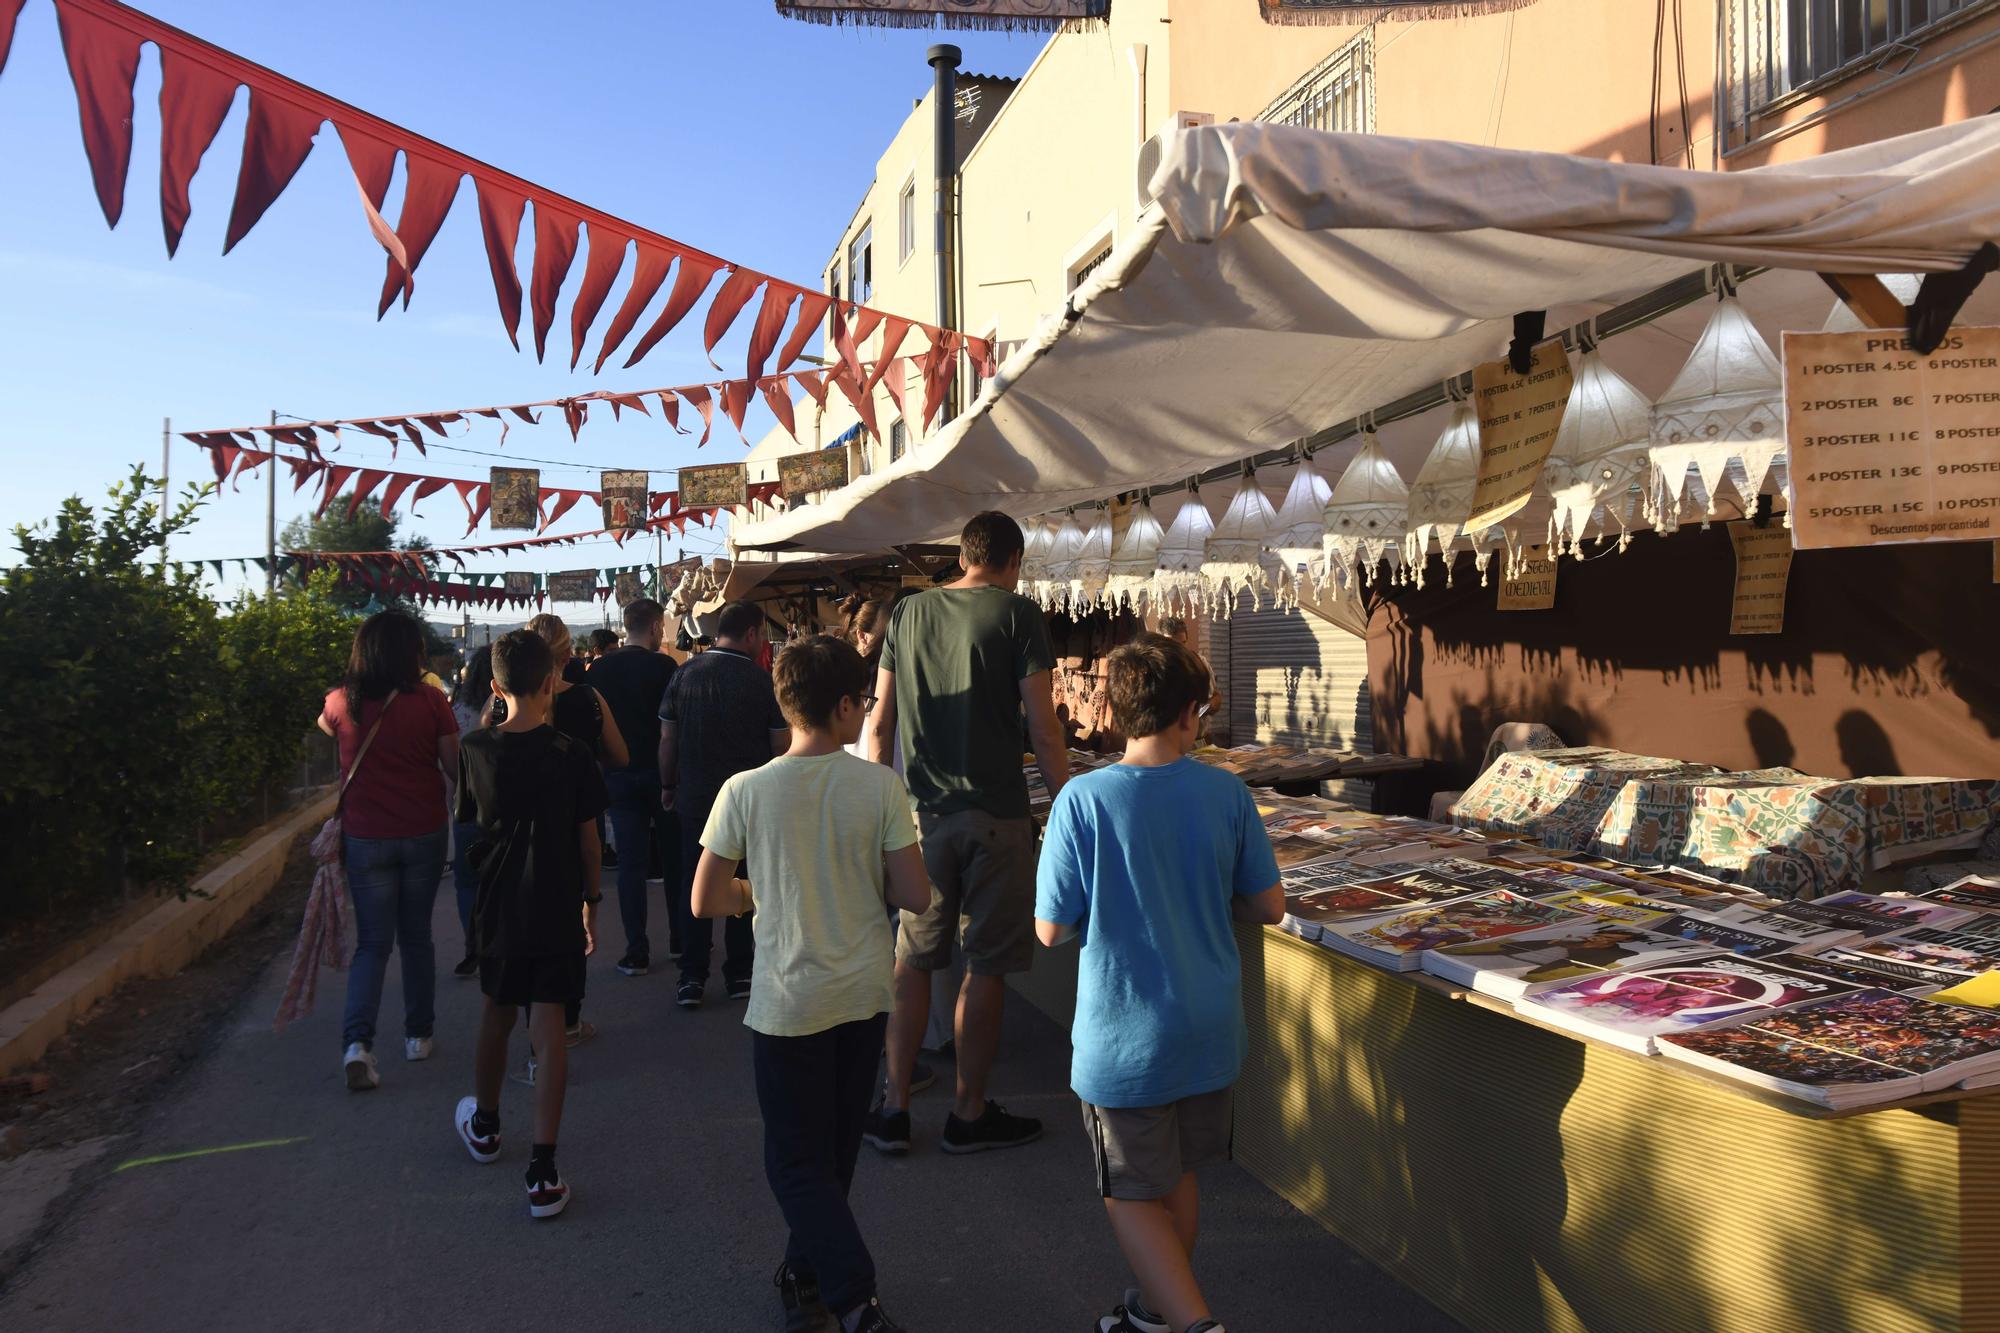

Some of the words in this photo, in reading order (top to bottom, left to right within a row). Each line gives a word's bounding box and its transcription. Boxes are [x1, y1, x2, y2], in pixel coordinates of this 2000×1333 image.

[1867, 336, 1964, 353] PREOS
[1814, 363, 1875, 374] POSTER
[1883, 361, 1917, 372] 4.5€
[1929, 360, 1938, 370] 6
[1942, 358, 1997, 369] POSTER
[1533, 370, 1556, 385] POSTER
[1483, 384, 1509, 398] POSTER
[1932, 394, 1942, 404] 7
[1945, 392, 2000, 404] POSTER
[1533, 400, 1556, 415] POSTER
[1802, 401, 1812, 411] 2
[1816, 398, 1878, 410] POSTER
[1892, 396, 1914, 406] 8€
[1487, 415, 1510, 428] POSTER
[1804, 436, 1814, 447] 3
[1818, 433, 1880, 446] POSTER
[1935, 429, 1945, 439] 8
[1806, 472, 1816, 482] 4
[1820, 469, 1881, 482] POSTER
[1891, 466, 1922, 478] 13€
[1938, 465, 1948, 475] 9
[1951, 462, 2000, 474] POSTE
[1809, 508, 1819, 518] 5
[1823, 504, 1883, 517] POSTER
[1892, 502, 1923, 513] 15€
[1938, 500, 1957, 511] 10
[1960, 497, 2000, 509] POST
[1870, 523, 1929, 536] Descuentos
[1931, 522, 1947, 535] por
[1949, 518, 1990, 531] cantidad
[1505, 580, 1551, 597] MEDIEVAL
[1787, 904, 1838, 918] Ariana
[1841, 914, 1907, 929] Grande
[1680, 919, 1732, 937] Taylor
[1731, 932, 1778, 948] Swift
